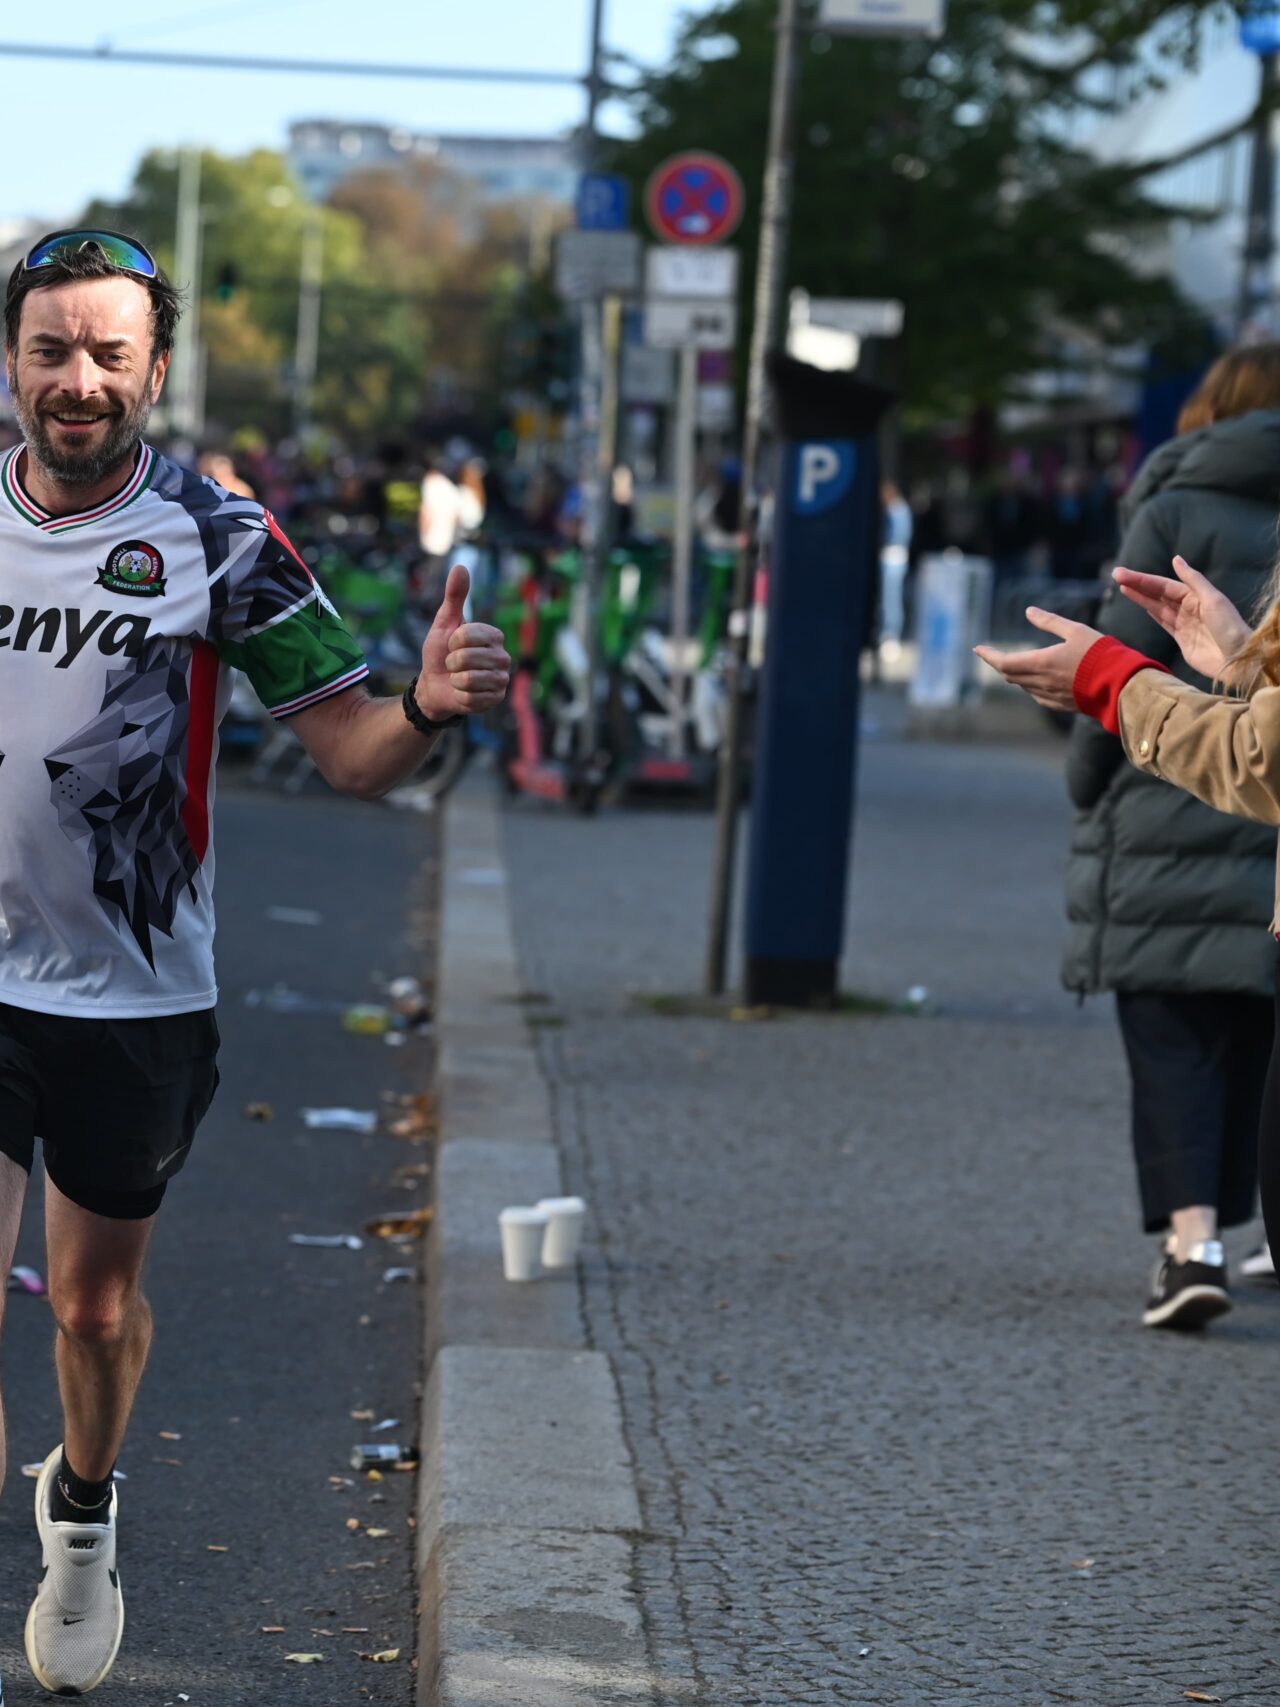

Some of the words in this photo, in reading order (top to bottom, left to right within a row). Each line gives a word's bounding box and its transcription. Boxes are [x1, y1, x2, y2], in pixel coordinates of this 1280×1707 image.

[799, 446, 840, 502] P
[111, 547, 128, 577] FOOTBALL
[112, 580, 151, 591] FEDERATION
[68, 1538, 99, 1550] NIKE
